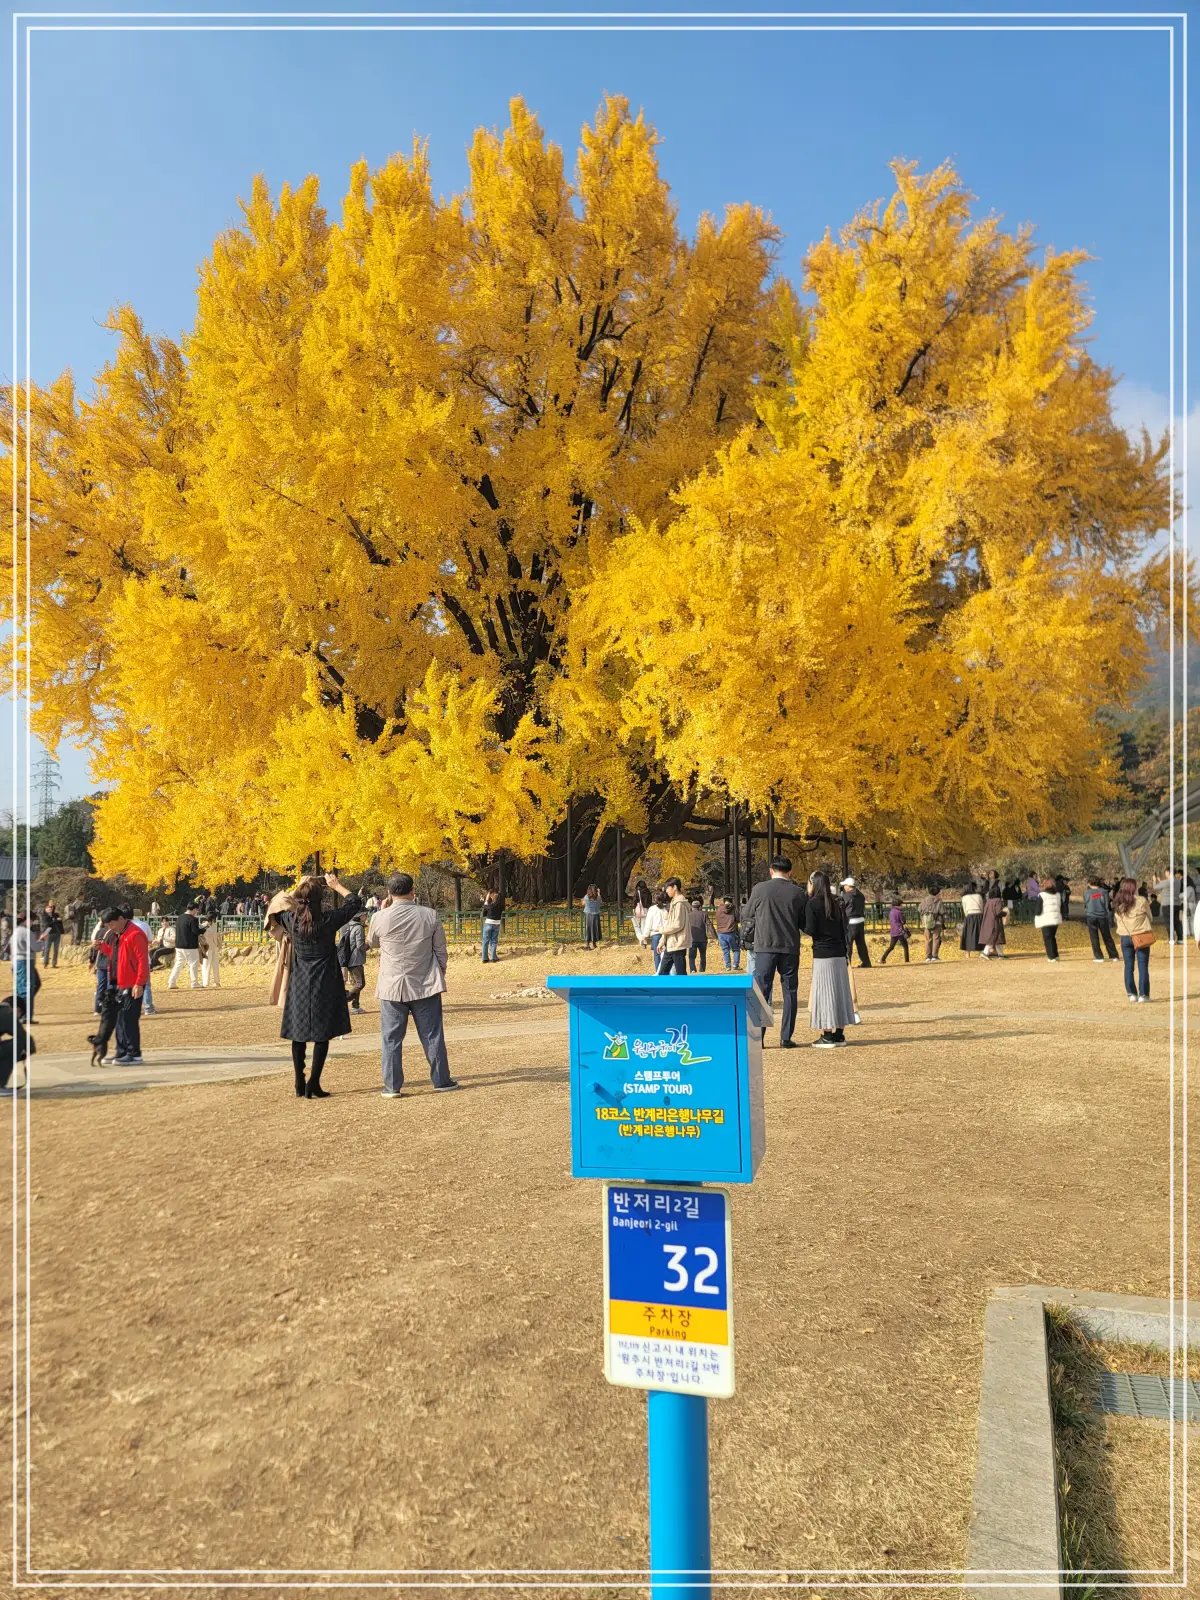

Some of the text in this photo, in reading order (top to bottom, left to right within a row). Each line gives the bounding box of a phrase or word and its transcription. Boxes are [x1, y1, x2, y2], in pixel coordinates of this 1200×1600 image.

[623, 1083, 693, 1096] (STAMP TOUR)
[595, 1107, 724, 1124] 18코스 반계리은행나무길
[618, 1124, 701, 1138] (반계리은행나무)
[613, 1192, 699, 1219] 반저리2길
[612, 1216, 679, 1232] Banjeori 2-gil
[663, 1244, 720, 1295] 32
[643, 1306, 692, 1327] 주차장
[649, 1326, 687, 1340] Parking
[675, 1345, 684, 1355] 내
